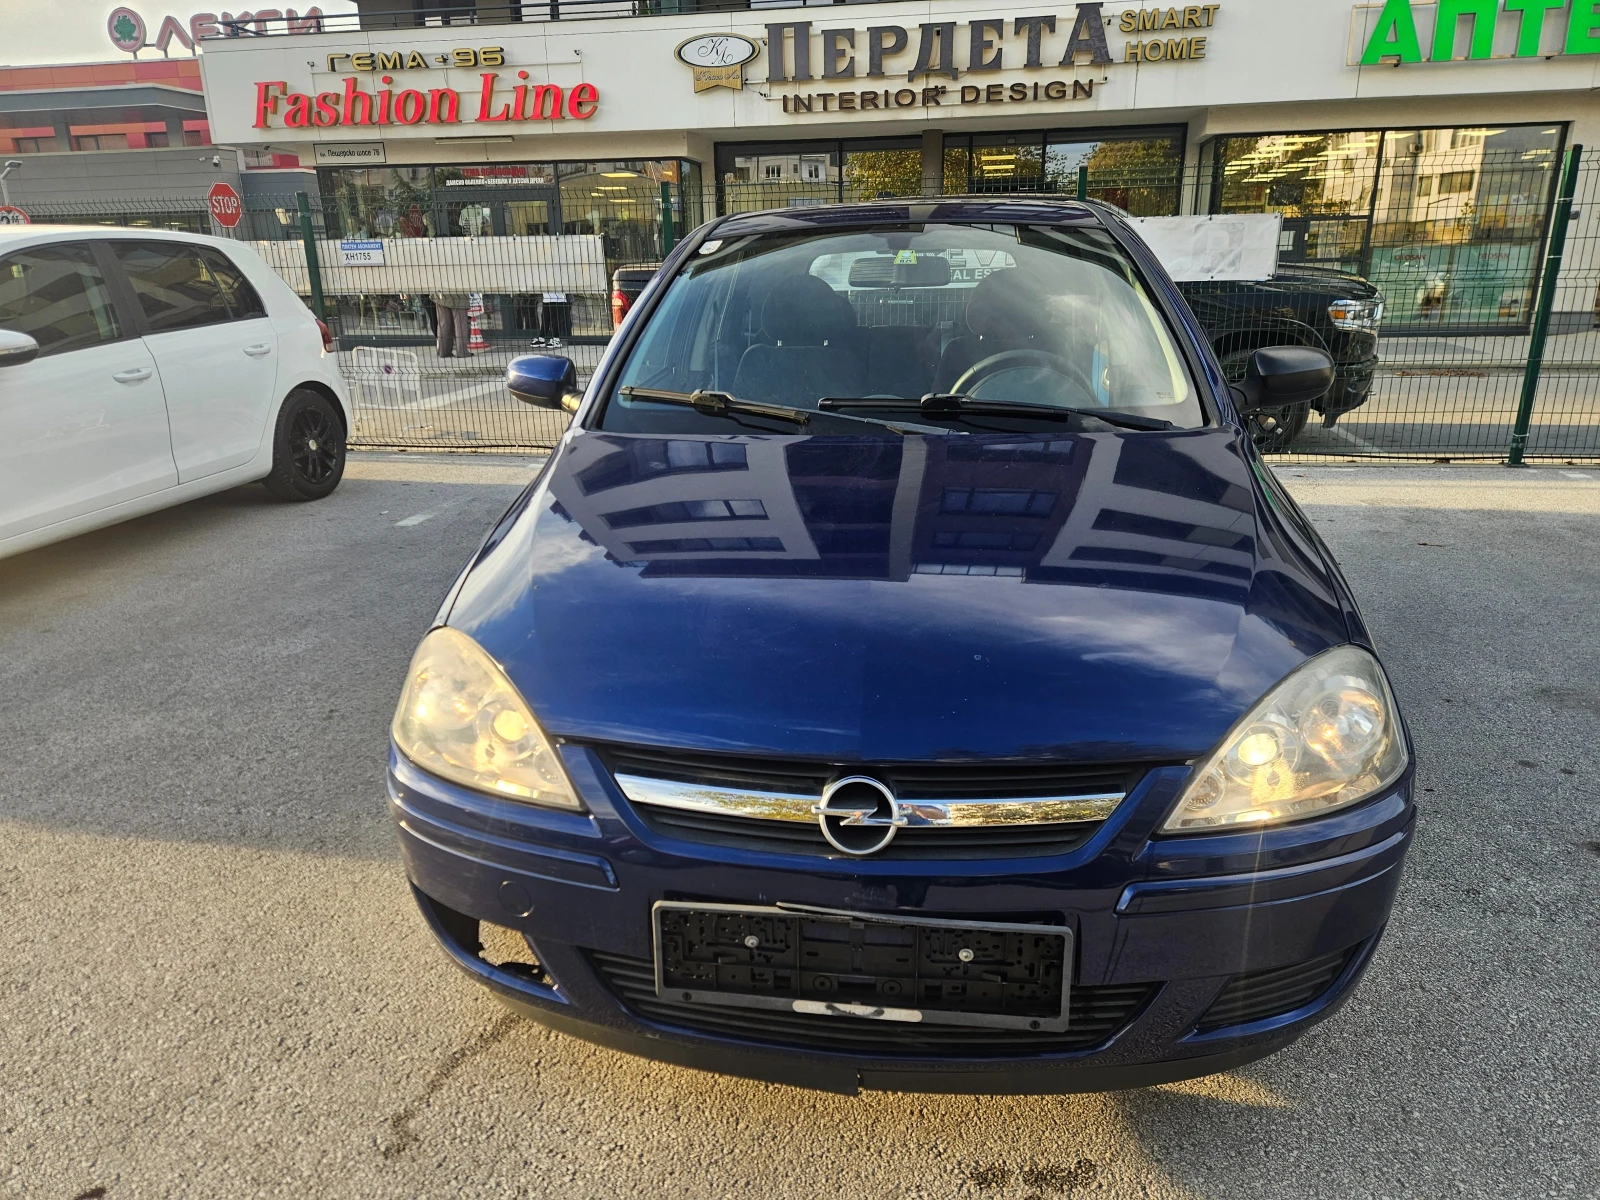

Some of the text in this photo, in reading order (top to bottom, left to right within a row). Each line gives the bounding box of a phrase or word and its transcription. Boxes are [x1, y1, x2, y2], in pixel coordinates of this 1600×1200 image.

[1119, 4, 1220, 33] SMART
[764, 2, 1113, 83] ПЕРДЕТА
[1124, 36, 1207, 63] HOME
[251, 70, 600, 129] Fashion Line
[782, 79, 1094, 114] INTERIOR DESIGN
[212, 195, 237, 213] STOP
